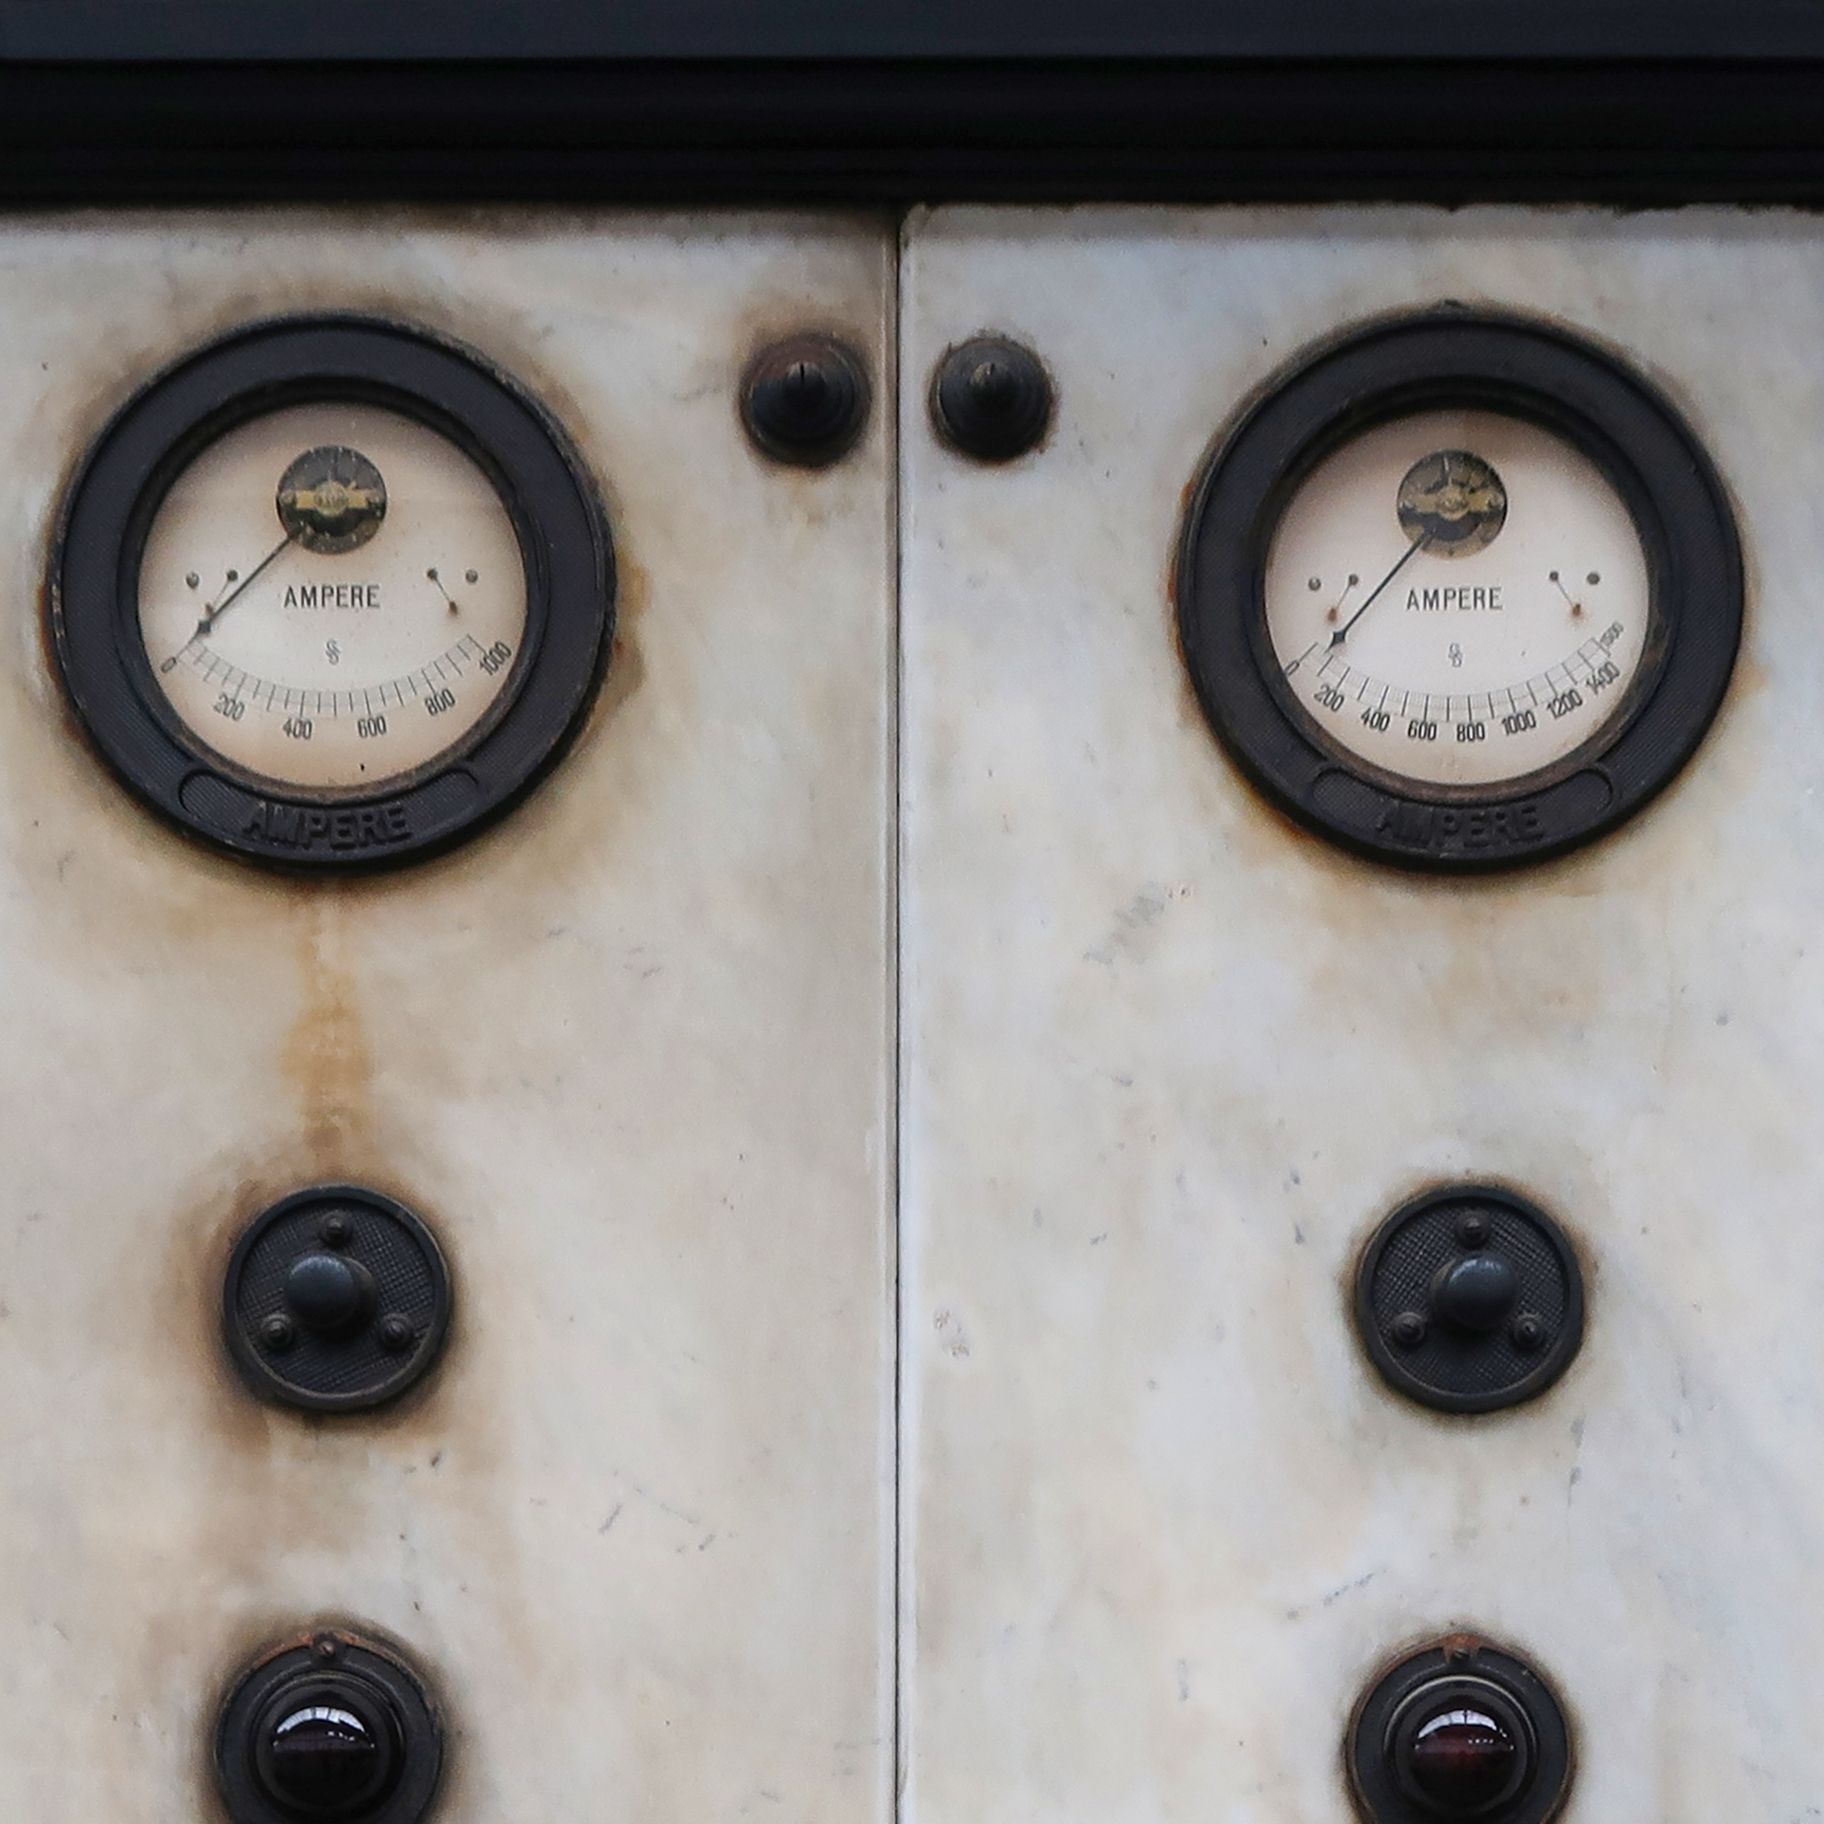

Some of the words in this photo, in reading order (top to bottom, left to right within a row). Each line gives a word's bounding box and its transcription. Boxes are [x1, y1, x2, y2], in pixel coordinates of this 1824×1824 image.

[284, 585, 381, 608] AMPERE
[1406, 587, 1503, 611] AMPERE
[213, 695, 245, 721] 200
[283, 720, 312, 739] 400
[358, 716, 387, 738] 600
[425, 689, 456, 717] 800
[479, 642, 512, 676] 1000
[1314, 685, 1345, 712] 200
[1361, 709, 1390, 733] 400
[1407, 720, 1437, 741] 600
[1456, 723, 1485, 742] 800
[1501, 710, 1537, 736] 1000
[1547, 689, 1583, 719] 1200
[1586, 662, 1621, 696] 1400
[242, 803, 413, 851] AMPERE
[1376, 803, 1544, 849] AMPERE
